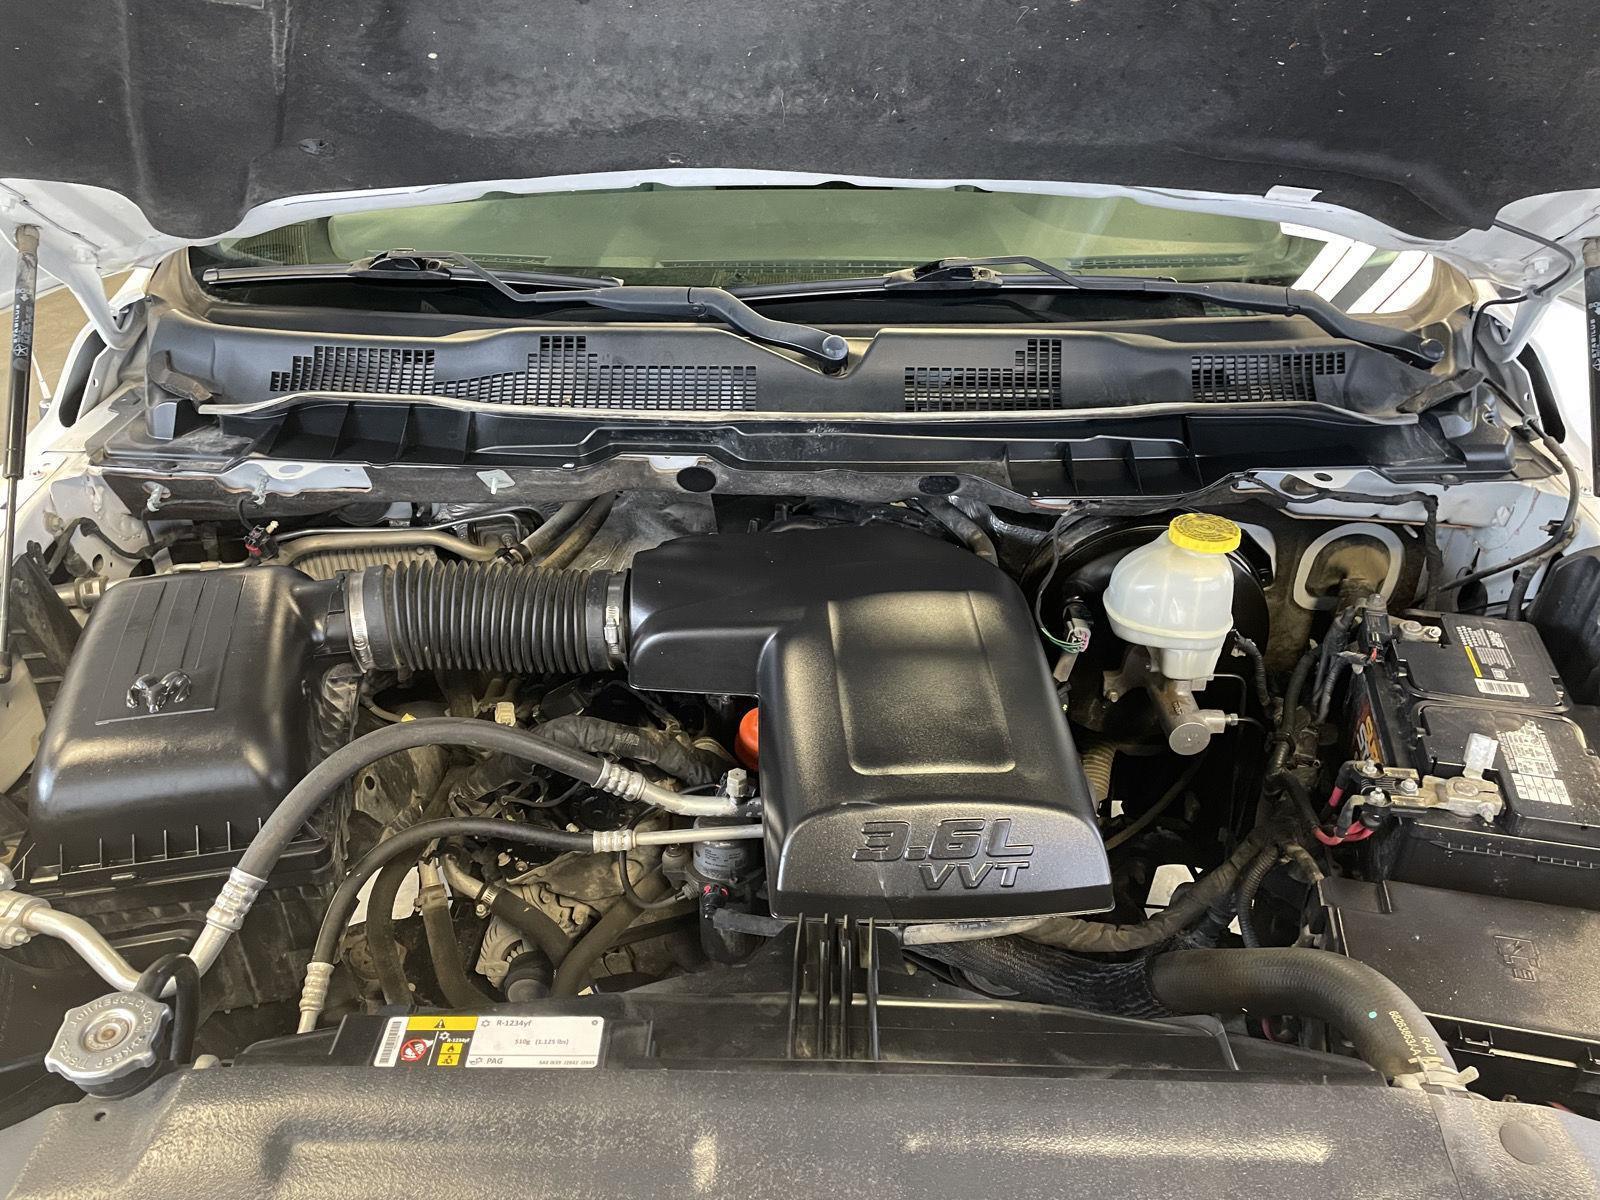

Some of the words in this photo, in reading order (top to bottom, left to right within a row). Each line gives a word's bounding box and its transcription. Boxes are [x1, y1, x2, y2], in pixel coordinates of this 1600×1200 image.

[851, 818, 1035, 862] 3.6L
[918, 860, 1031, 891] VVT
[496, 1019, 532, 1028] R-1234yf
[1419, 1036, 1437, 1056] RAD
